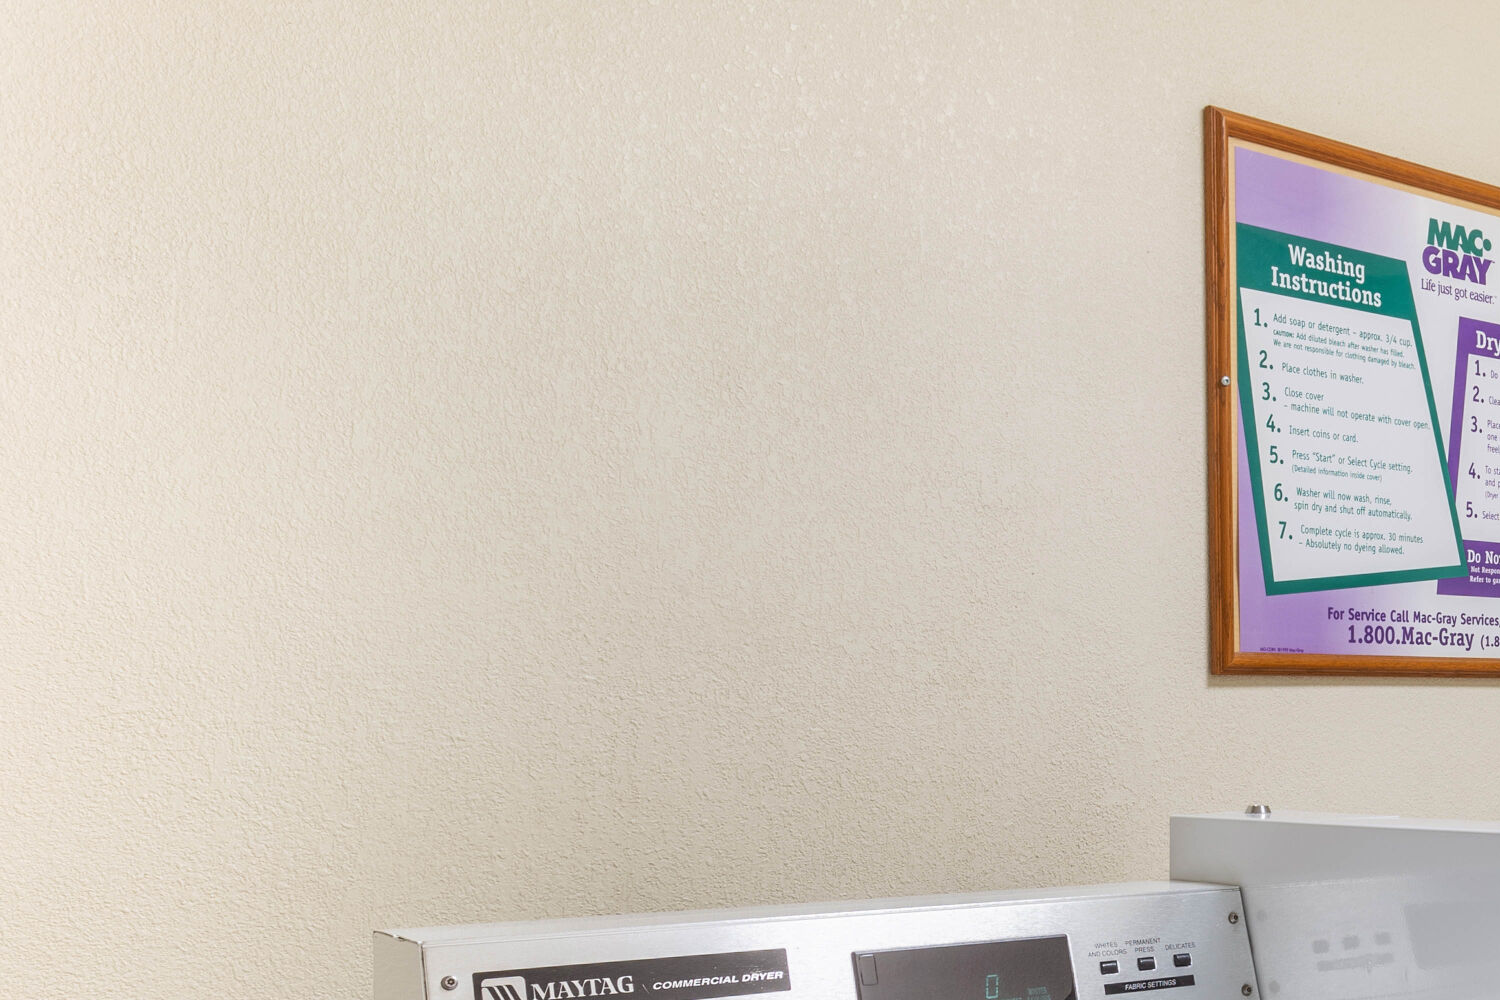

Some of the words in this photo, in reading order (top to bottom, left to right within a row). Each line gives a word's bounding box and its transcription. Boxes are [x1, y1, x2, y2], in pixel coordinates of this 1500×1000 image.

[1288, 244, 1365, 284] Washing
[1422, 245, 1493, 286] GRAY
[1271, 266, 1382, 308] Instructions
[1421, 278, 1436, 292] Life
[1438, 281, 1452, 296] just
[1454, 288, 1468, 301] got
[1254, 308, 1268, 328] 1.
[1273, 313, 1288, 324] Add
[1288, 318, 1306, 329] soap
[1308, 321, 1316, 329] or
[1318, 321, 1351, 336] detergent
[1359, 331, 1384, 342] approx.
[1385, 334, 1398, 345] 3/4
[1399, 336, 1413, 348] cup.
[1259, 350, 1274, 370] 2.
[1282, 363, 1301, 374] Place
[1303, 366, 1328, 379] clothes
[1330, 370, 1337, 380] in
[1339, 373, 1364, 384] washer.
[1474, 360, 1486, 377] 1.
[1491, 370, 1499, 380] Do
[1262, 382, 1276, 402] 3.
[1285, 387, 1303, 399] Close
[1306, 392, 1324, 401] cover
[1472, 386, 1484, 403] 2.
[1291, 403, 1320, 414] machine
[1322, 406, 1335, 417] will
[1337, 410, 1349, 419] not
[1351, 412, 1376, 422] operate
[1378, 415, 1393, 424] with
[1394, 419, 1412, 427] cover
[1413, 420, 1431, 432] open.
[1470, 416, 1482, 434] 3.
[1266, 414, 1281, 432] 4.
[1290, 425, 1310, 437] Insert
[1313, 429, 1331, 440] coins
[1342, 434, 1359, 443] card.
[1270, 445, 1284, 464] 5.
[1292, 450, 1310, 461] Press
[1338, 457, 1346, 465] or
[1348, 456, 1368, 468] Select
[1370, 459, 1387, 471] Cycle
[1389, 463, 1413, 475] setting.
[1468, 462, 1480, 480] 4.
[1485, 466, 1492, 474] To
[1274, 482, 1288, 502] 6.
[1297, 487, 1321, 498] Washer
[1323, 490, 1336, 500] will
[1338, 493, 1352, 501] now
[1354, 494, 1372, 504] wash,
[1375, 495, 1392, 506] rinse,
[1295, 501, 1309, 512] spin
[1312, 502, 1323, 514] dry
[1325, 504, 1337, 513] and
[1340, 505, 1355, 515] shut
[1357, 506, 1366, 516] off
[1368, 509, 1413, 522] automatically.
[1466, 501, 1478, 519] 5.
[1482, 511, 1500, 521] Select
[1278, 520, 1293, 540] 7.
[1301, 524, 1333, 537] Complete
[1335, 528, 1352, 540] cycle
[1354, 529, 1360, 539] is
[1362, 532, 1386, 541] approx.
[1389, 532, 1397, 542] 30
[1399, 533, 1424, 544] minutes
[1305, 538, 1342, 553] Absolutely
[1344, 543, 1353, 551] no
[1354, 542, 1377, 555] dyeing
[1378, 544, 1405, 555] allowed.
[1468, 549, 1481, 563] DO
[1328, 607, 1345, 620] For
[1349, 608, 1387, 622] Service
[1390, 610, 1409, 622] Call
[1413, 611, 1457, 627] Mac-Gray
[1348, 624, 1474, 651] 1.800.Mac-Gray
[1094, 942, 1118, 950] WHITES
[1125, 938, 1161, 946] PERMANENT
[1164, 942, 1196, 951] DELICATES
[652, 976, 739, 990] COMMERCIAL
[742, 971, 784, 982] DRYER
[1124, 981, 1146, 991] FABRIC
[1147, 979, 1176, 989] SETTINGS
